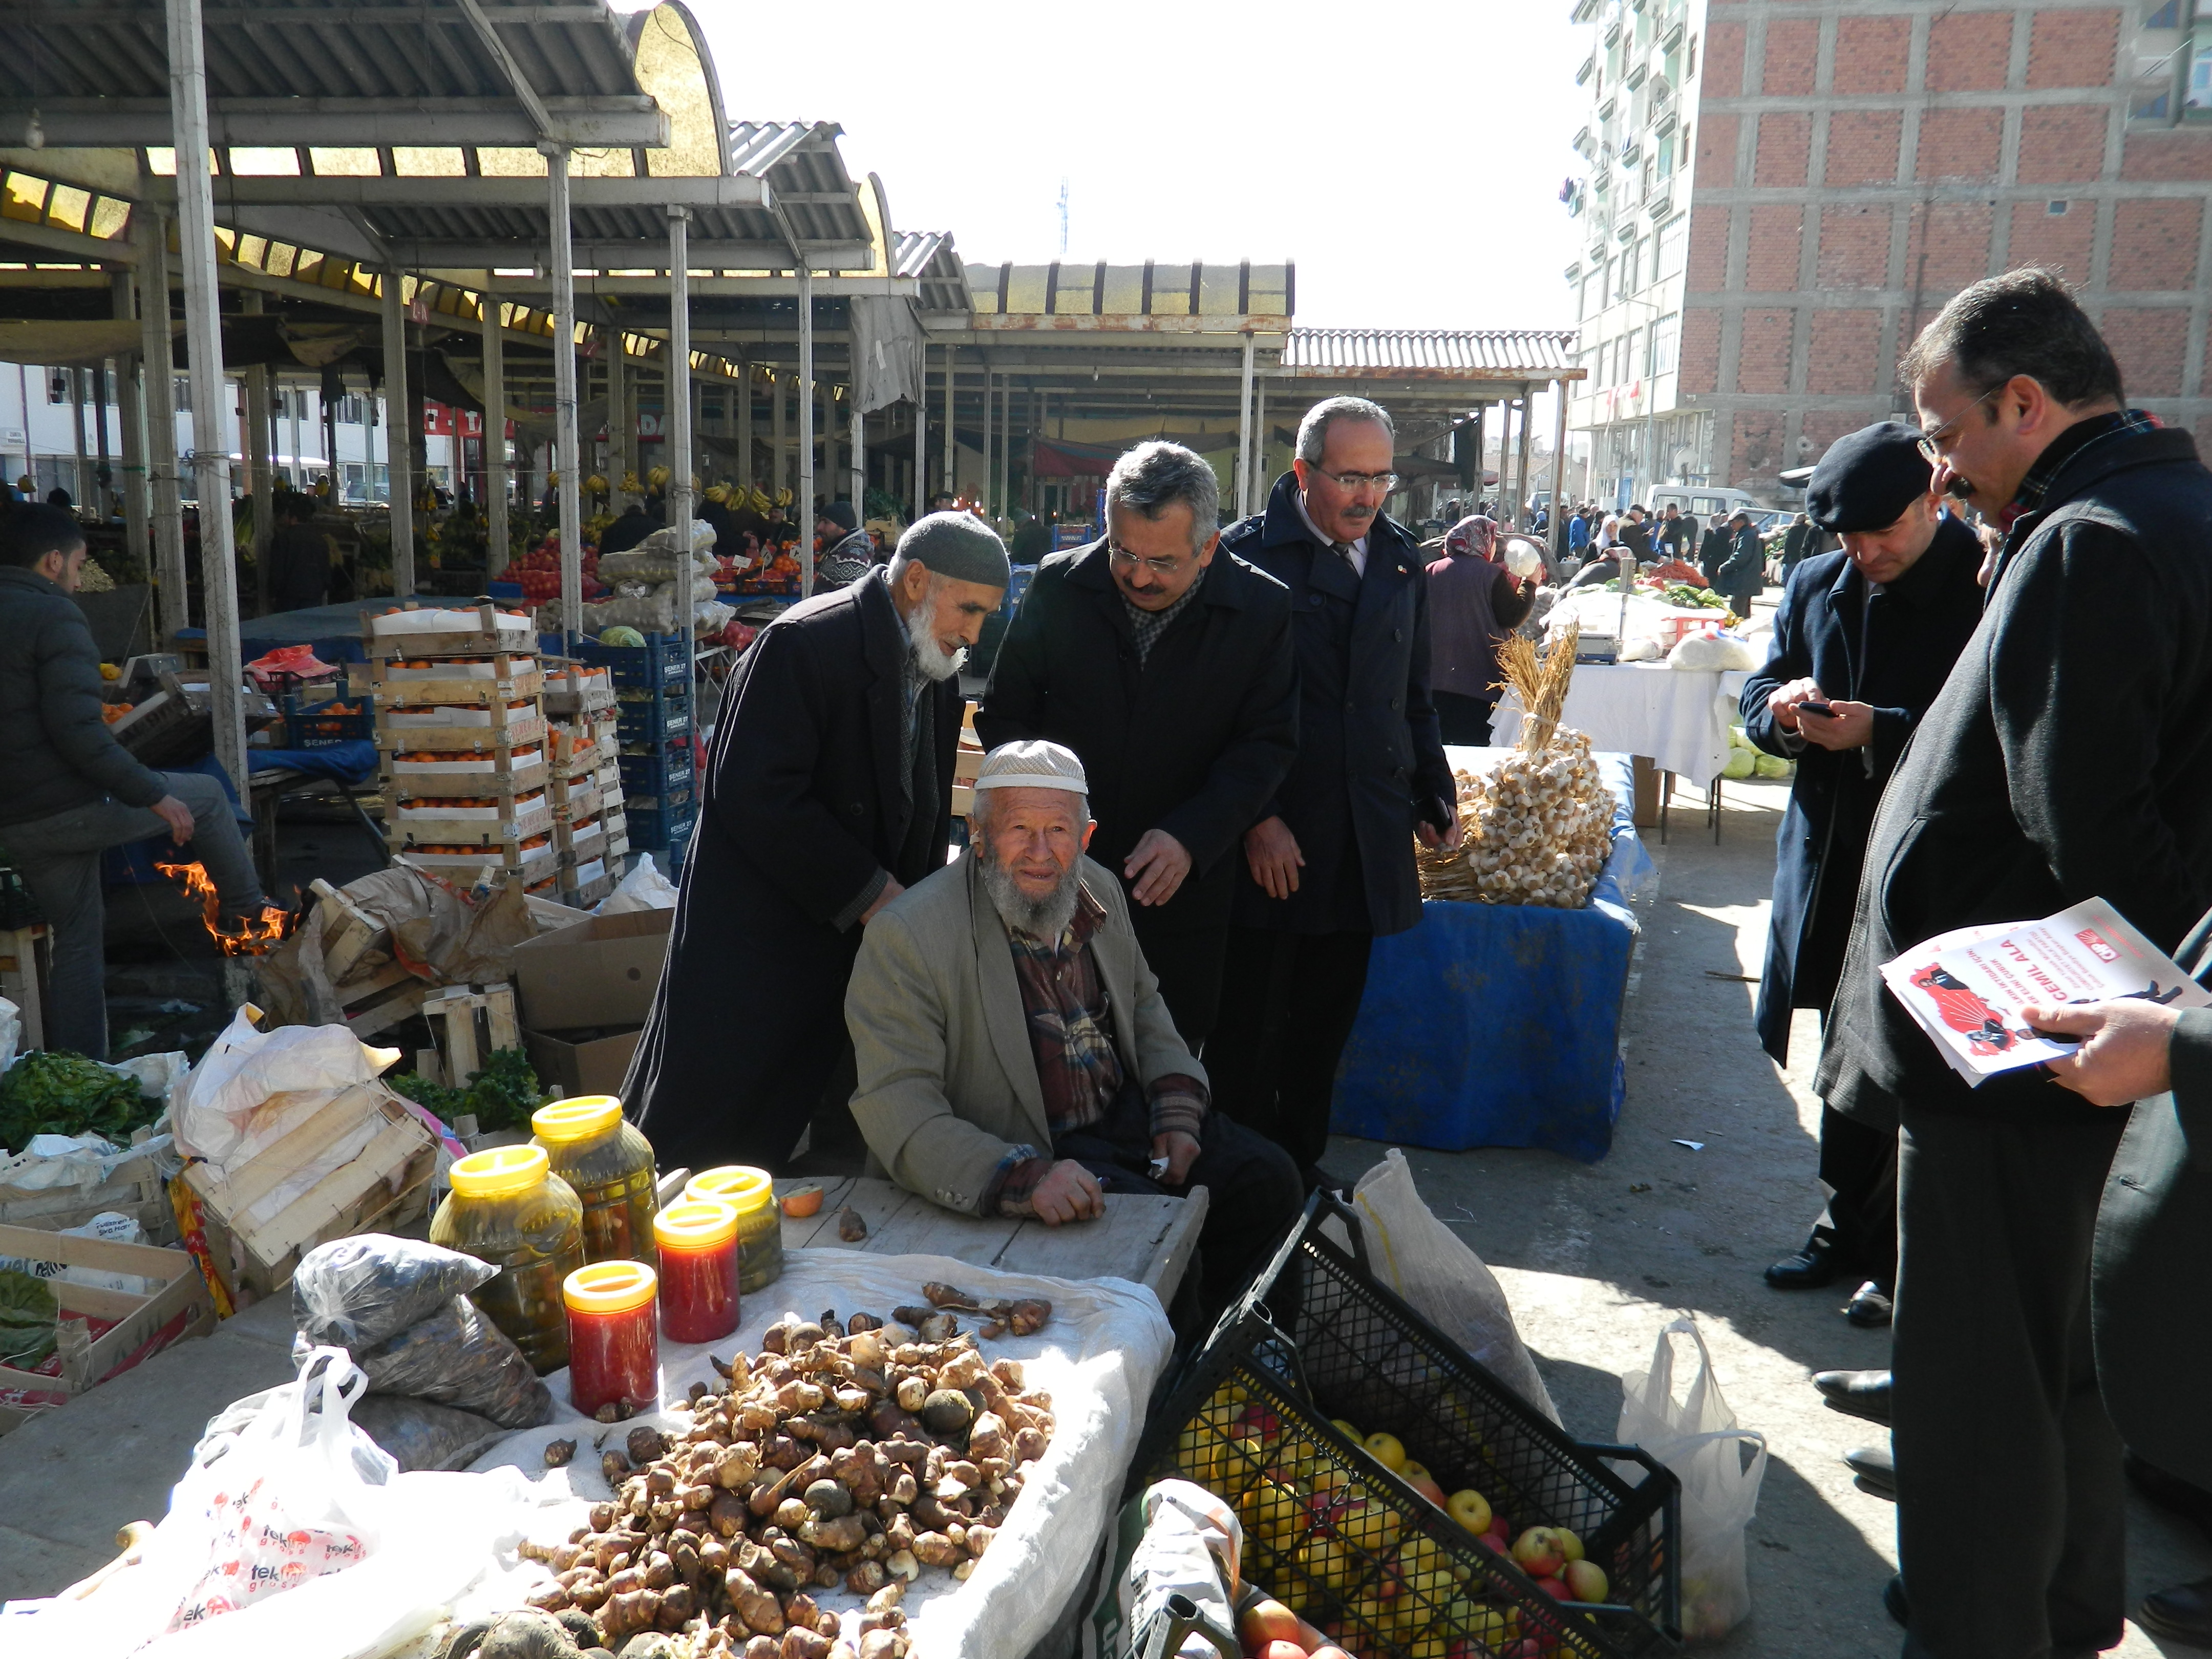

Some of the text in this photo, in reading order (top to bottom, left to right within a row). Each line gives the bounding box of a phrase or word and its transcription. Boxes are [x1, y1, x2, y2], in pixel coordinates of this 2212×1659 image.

[2091, 943, 2117, 961] CHP
[1990, 959, 2014, 979] ÇUBUK
[2000, 940, 2068, 1001] CEMİL ALA
[2005, 989, 2025, 1005] LKIN
[2028, 996, 2041, 1005] ER
[264, 1524, 287, 1547] tek
[251, 1565, 279, 1581] tek
[183, 1603, 206, 1621] ek
